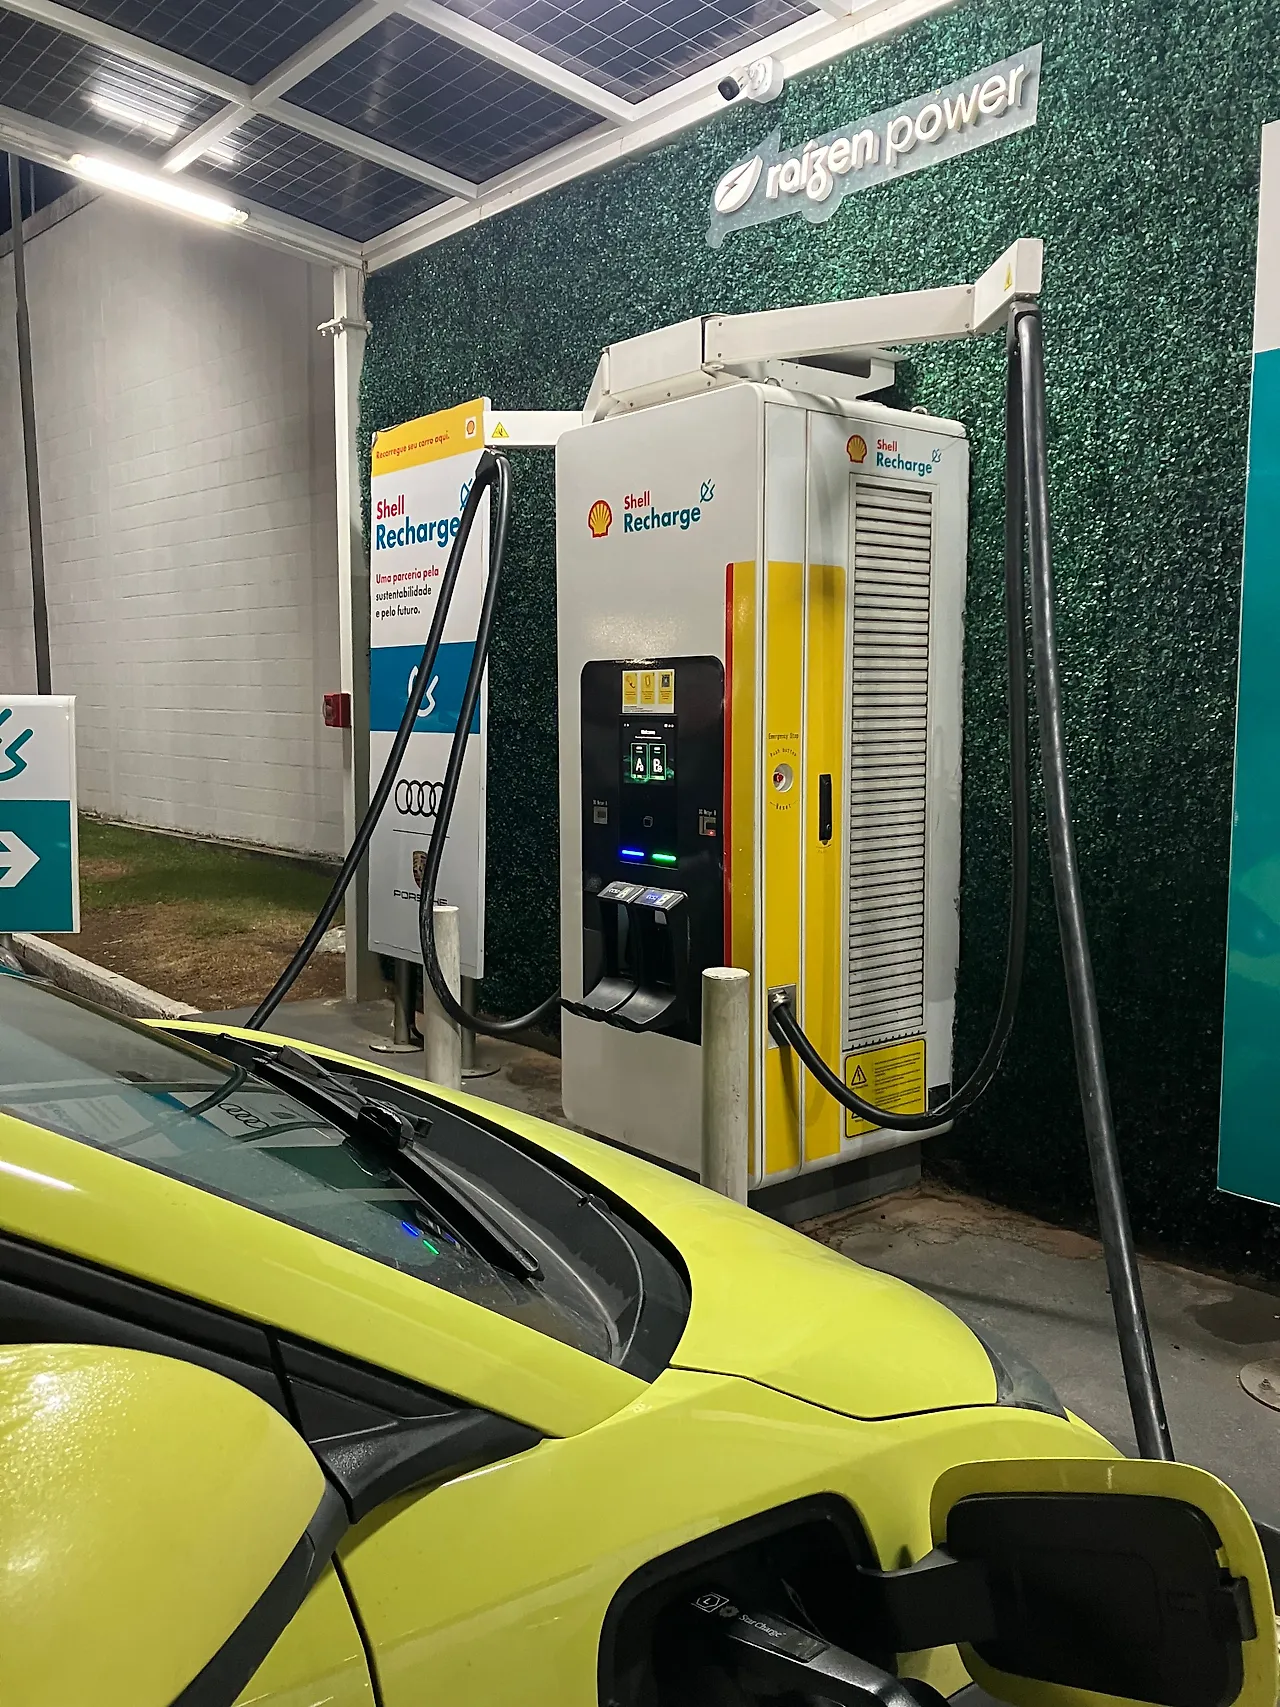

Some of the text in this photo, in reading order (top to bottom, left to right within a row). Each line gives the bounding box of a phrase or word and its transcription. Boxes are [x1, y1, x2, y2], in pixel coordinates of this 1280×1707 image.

[885, 64, 1029, 167] power
[408, 442, 418, 451] seu
[418, 438, 434, 448] carro
[876, 438, 898, 452] Shell
[876, 451, 933, 477] Recharge
[376, 494, 405, 520] Shell
[624, 490, 650, 510] Shell
[624, 506, 701, 533] Recharge
[376, 516, 460, 551] Recharge
[375, 564, 439, 585] Uma parceria pela
[375, 584, 432, 601] sustentabilidade
[375, 604, 421, 621] e pelo futuro.
